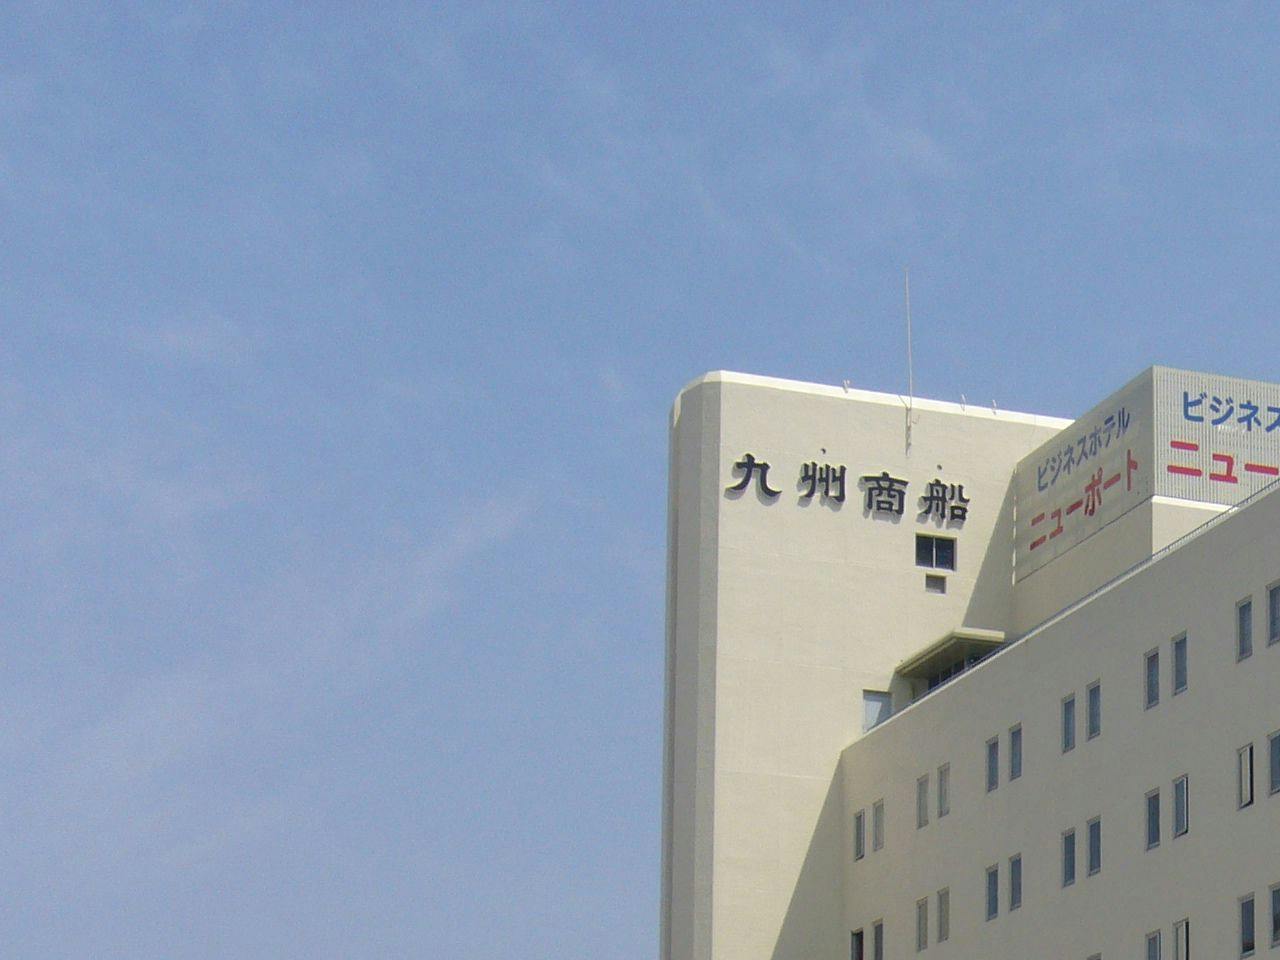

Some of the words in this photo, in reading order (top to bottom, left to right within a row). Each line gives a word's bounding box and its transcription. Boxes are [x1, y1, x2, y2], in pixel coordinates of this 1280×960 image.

[725, 453, 970, 521] 九州商船
[1038, 407, 1130, 492] ビジネスホテル
[1030, 449, 1138, 550] ニューポート
